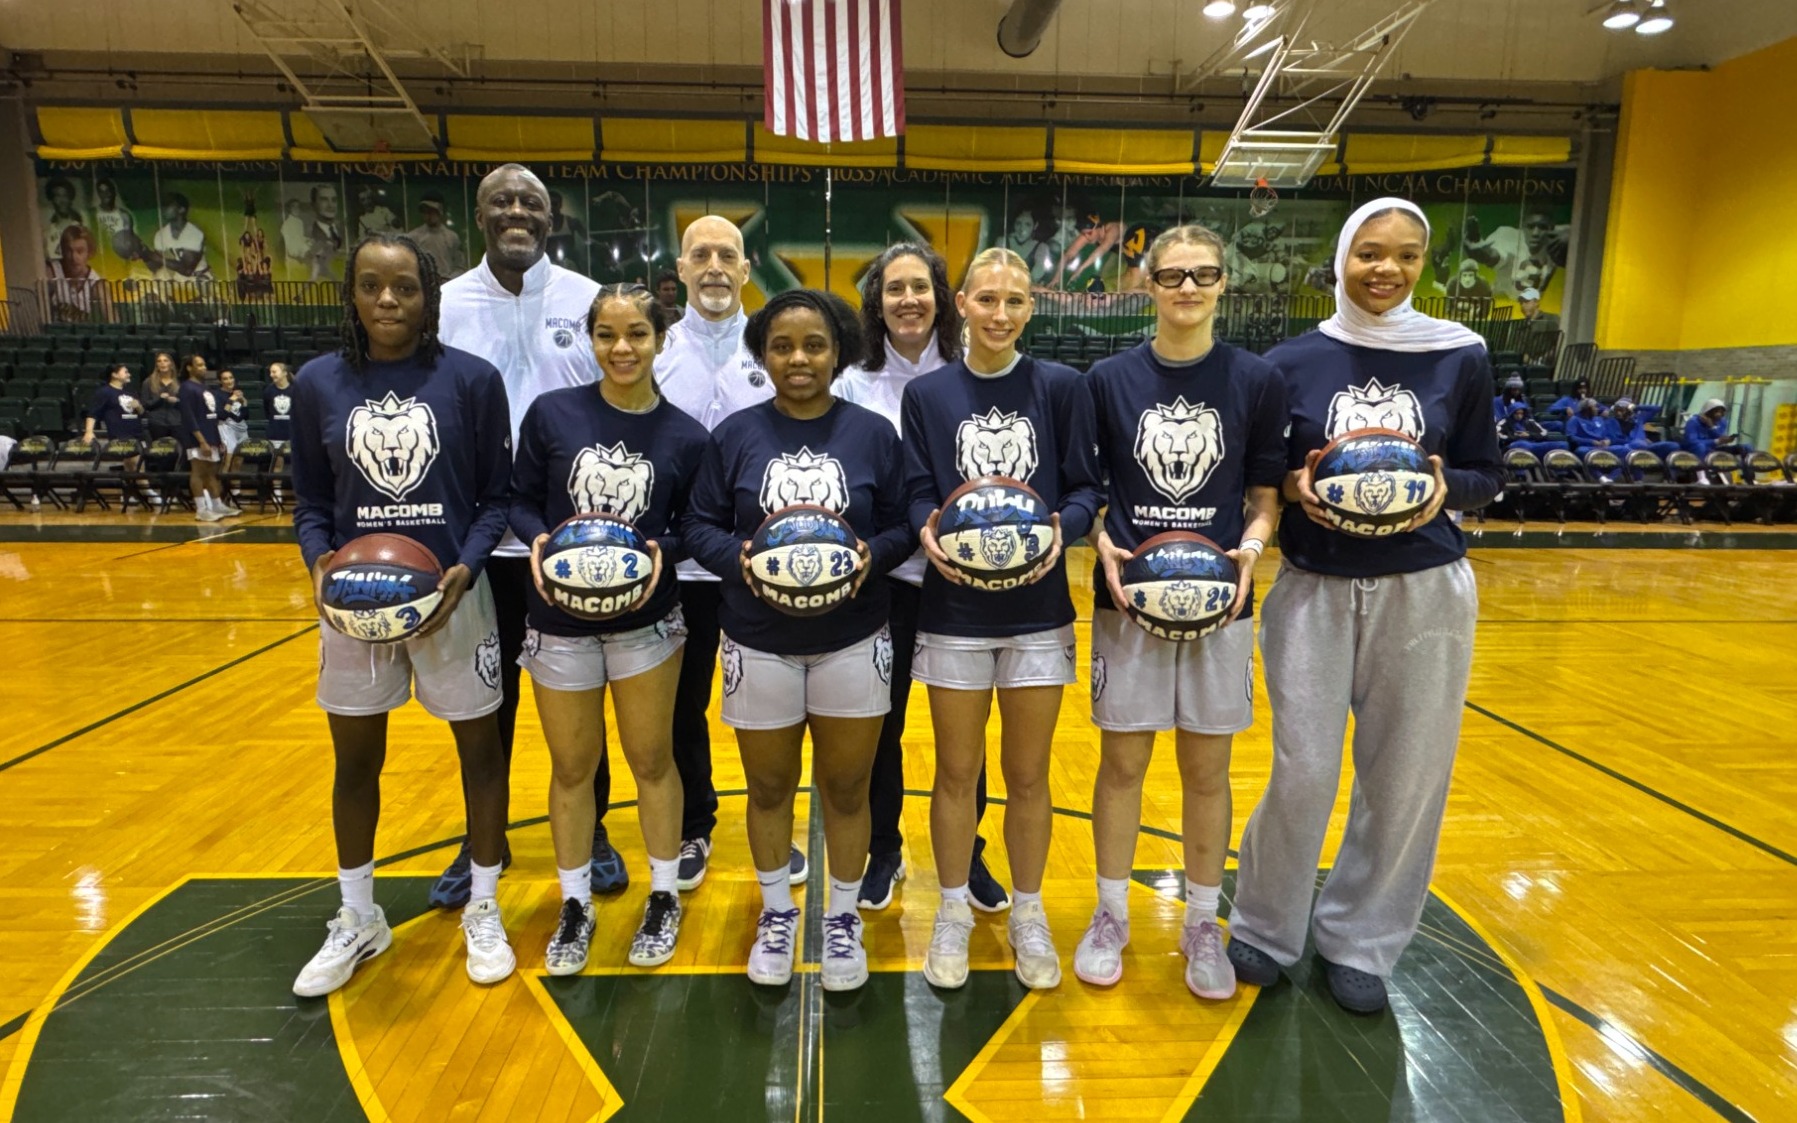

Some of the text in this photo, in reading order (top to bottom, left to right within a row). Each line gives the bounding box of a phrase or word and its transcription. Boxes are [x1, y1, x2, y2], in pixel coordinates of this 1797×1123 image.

[548, 165, 608, 180] TEAM
[616, 165, 812, 183] CHAMPIONSHIPS
[1364, 174, 1429, 193] NCAA
[1436, 174, 1565, 196] CHAMPIONS
[1326, 483, 1345, 504] #
[356, 518, 447, 528] WOMEN'S BASKETBALL
[357, 503, 443, 519] MACOMB
[1132, 519, 1168, 528] WOMEN'S
[1133, 505, 1217, 520] MACOMB
[766, 550, 854, 577] # 23
[957, 542, 976, 562] #
[554, 552, 639, 579] # 2
[554, 584, 643, 613] MACOMB
[762, 582, 852, 609] MACOMB
[1204, 586, 1231, 613] 24
[395, 605, 422, 630] 3
